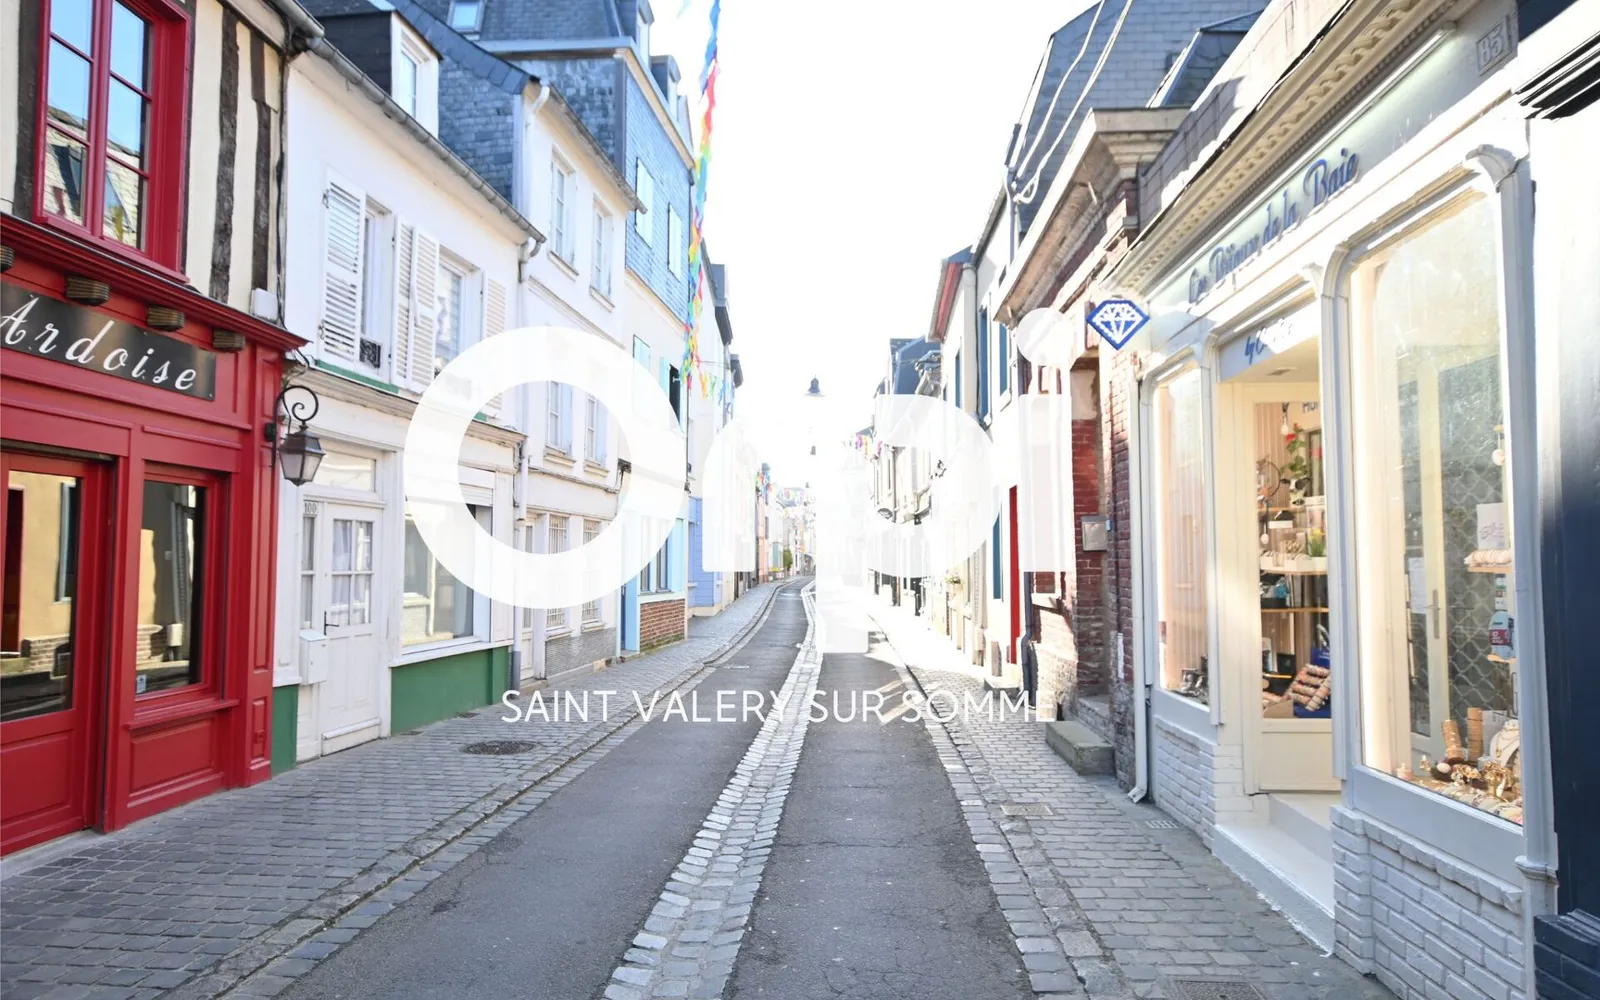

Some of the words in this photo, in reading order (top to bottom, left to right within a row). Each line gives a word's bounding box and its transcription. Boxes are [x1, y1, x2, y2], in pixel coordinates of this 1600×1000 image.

[1479, 26, 1504, 67] 85
[1262, 202, 1280, 246] de
[1282, 187, 1298, 230] la
[1303, 147, 1359, 209] Baie
[0, 297, 197, 390] Ardoise
[304, 502, 317, 514] 100
